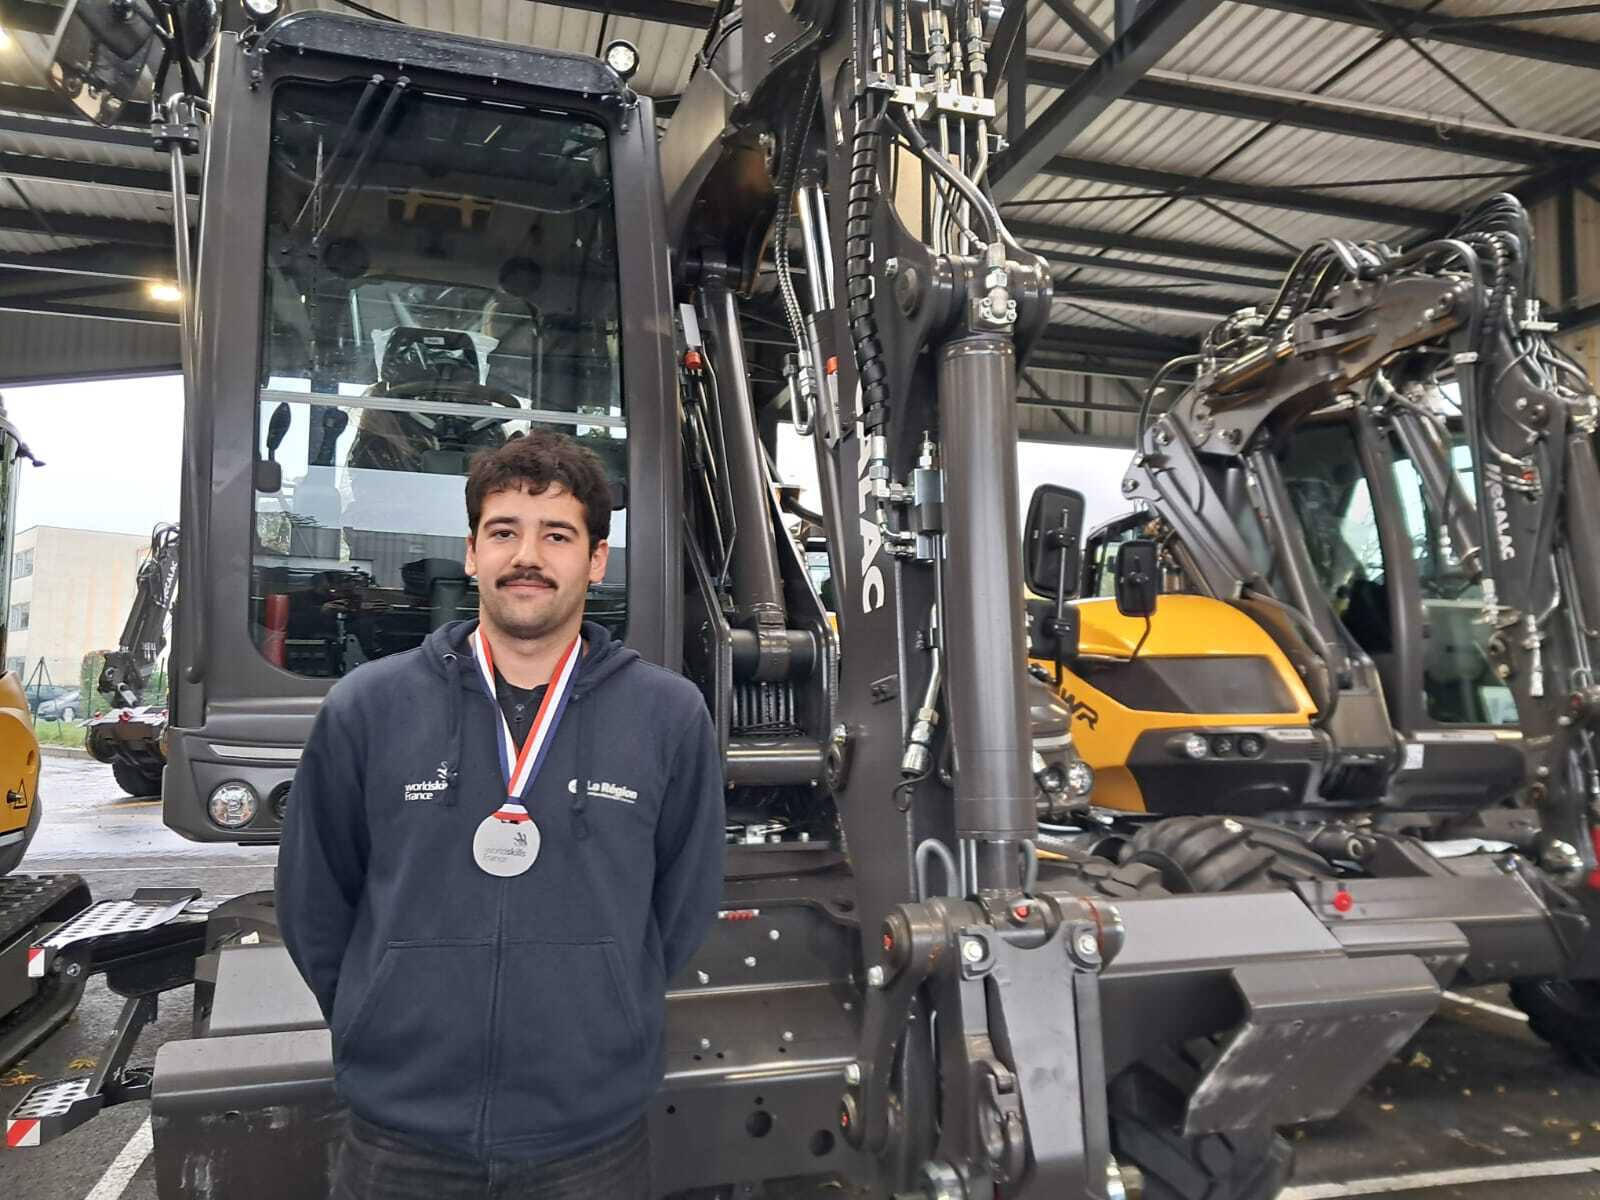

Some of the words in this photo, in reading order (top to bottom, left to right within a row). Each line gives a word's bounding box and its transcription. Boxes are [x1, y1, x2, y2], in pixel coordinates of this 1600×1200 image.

[404, 791, 434, 801] France
[587, 780, 600, 791] La
[601, 782, 638, 799] Région
